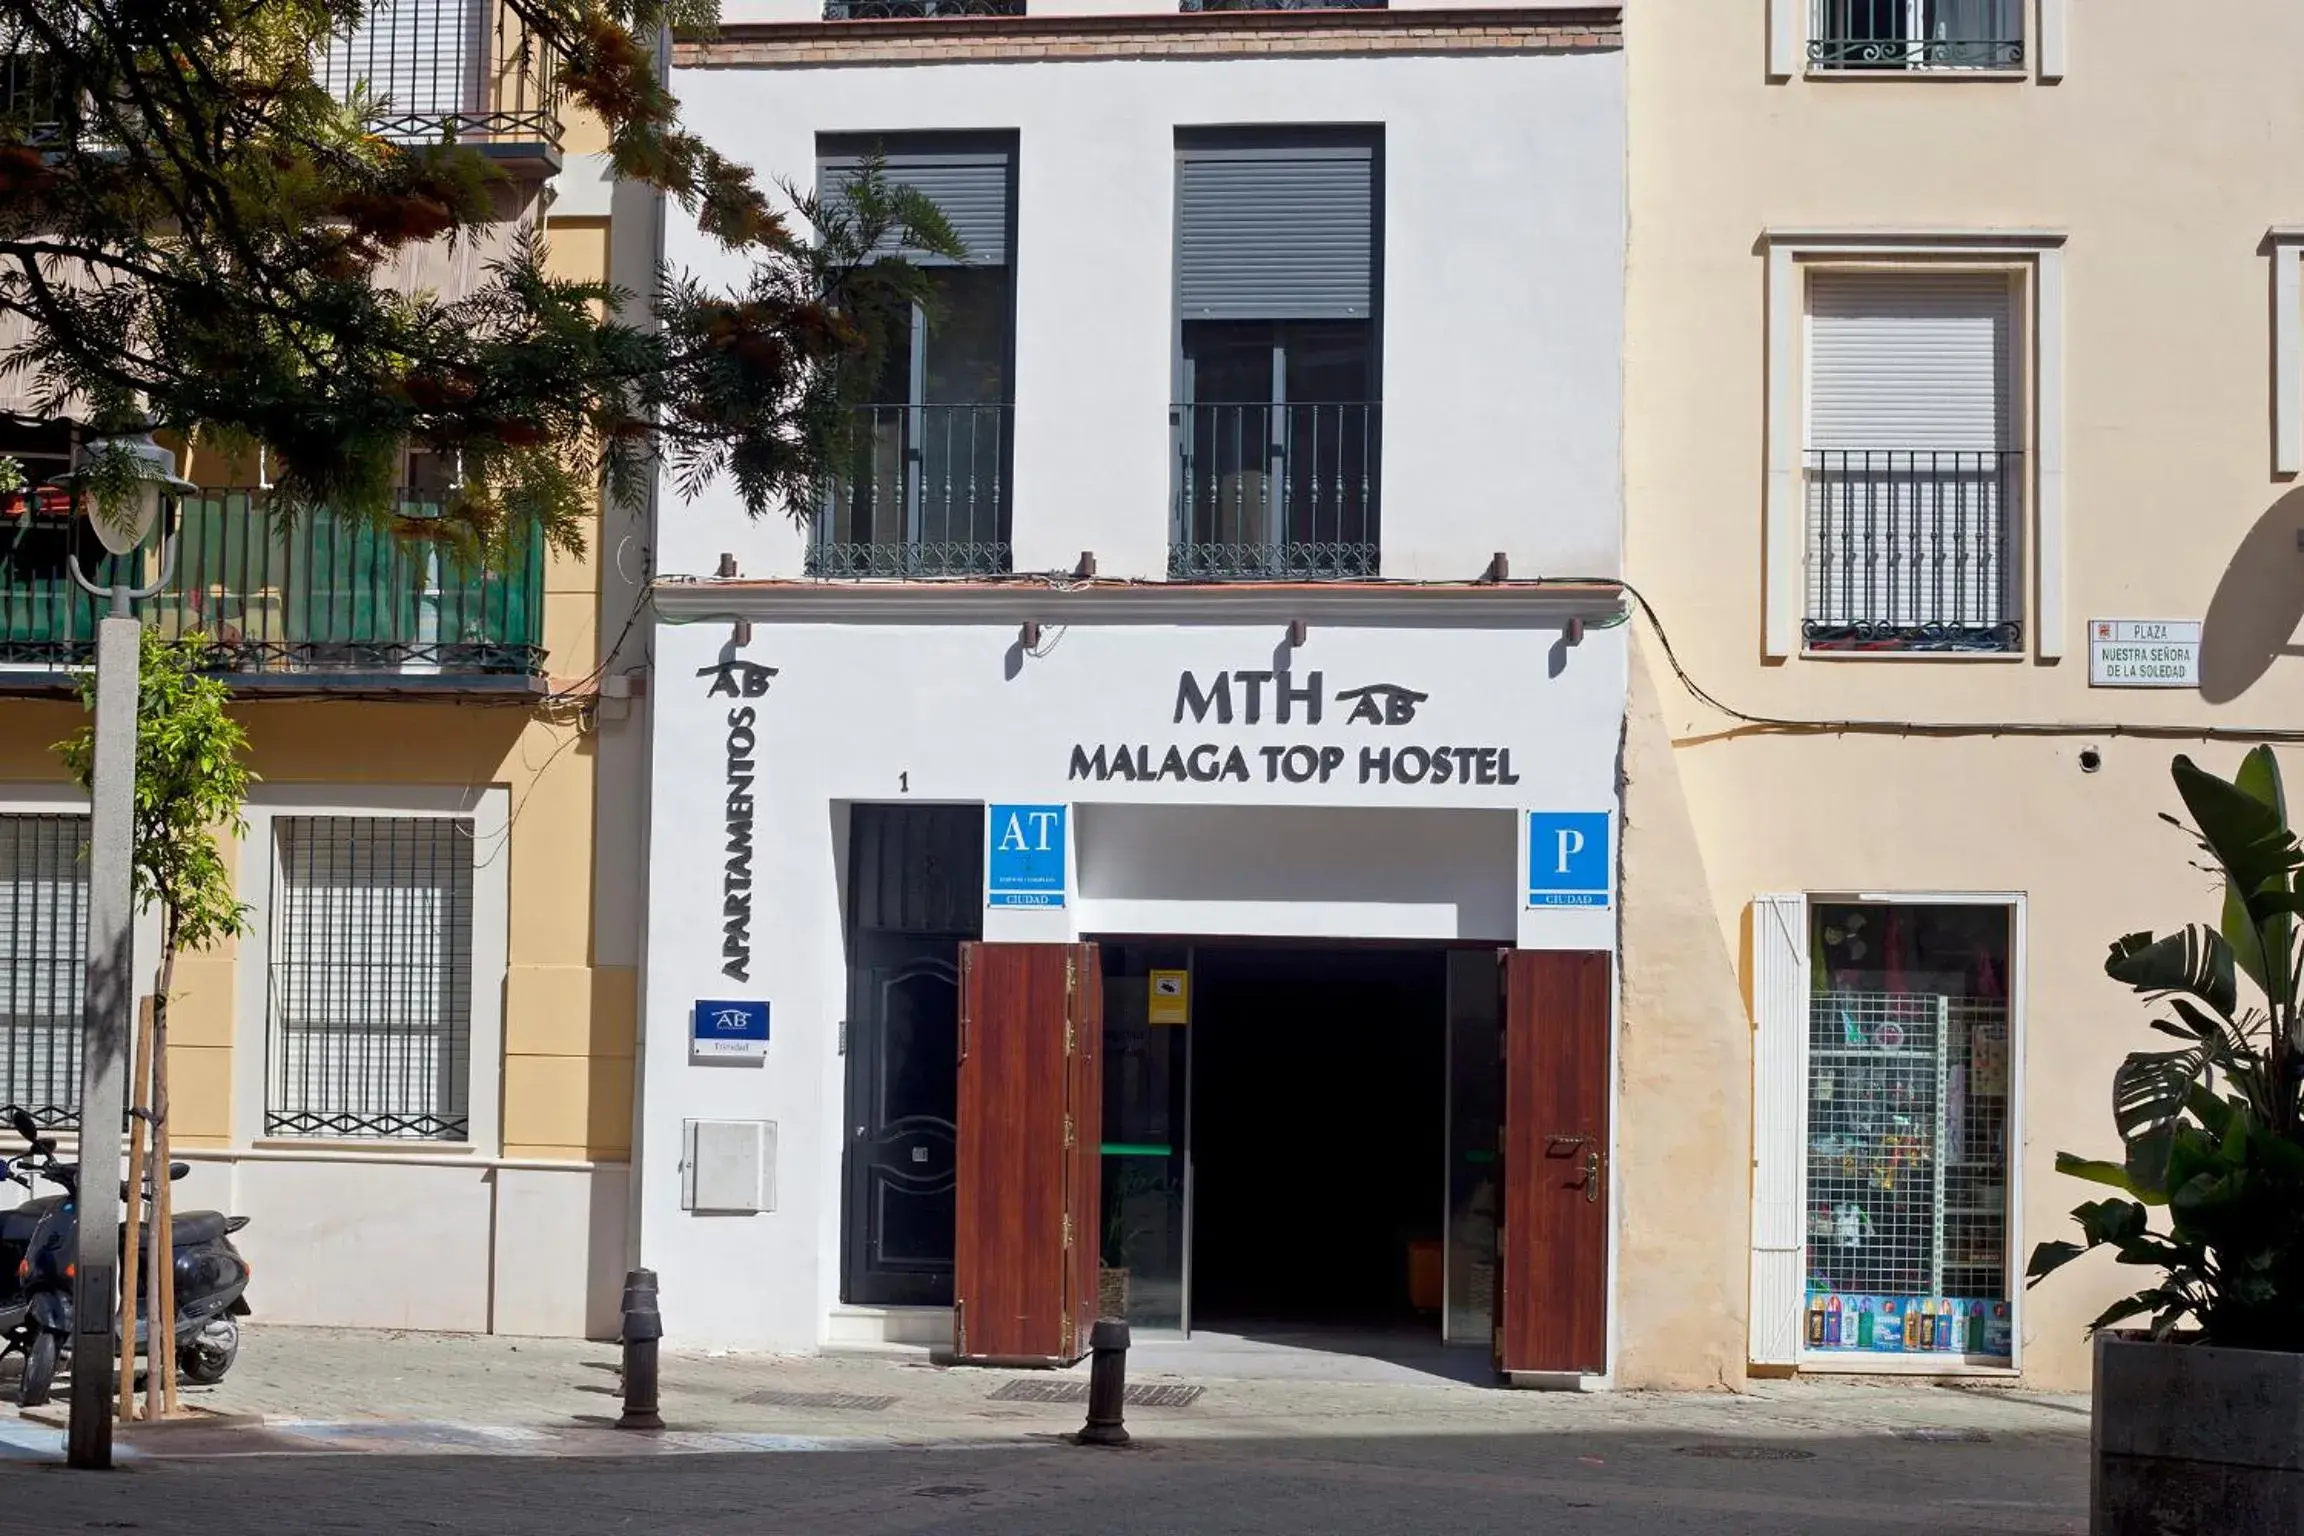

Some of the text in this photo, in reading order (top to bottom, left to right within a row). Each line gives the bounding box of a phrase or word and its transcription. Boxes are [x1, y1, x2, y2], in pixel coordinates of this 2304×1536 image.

[2134, 624, 2168, 640] PLAZA
[2102, 646, 2190, 661] NUESTRA SEÑORA
[699, 661, 776, 698] AB
[2107, 664, 2185, 678] DE LA SOLEDAD
[1173, 670, 1426, 725] MTH AB
[1068, 743, 1520, 785] MALAGA TOP HOSTEL
[899, 770, 909, 793] 1
[997, 810, 1058, 851] AT
[721, 705, 757, 984] APARTAMENTOS
[1553, 829, 1585, 874] P
[1006, 894, 1050, 905] CIUDAD
[1545, 894, 1593, 905] CIUDAD
[714, 1010, 751, 1028] AB
